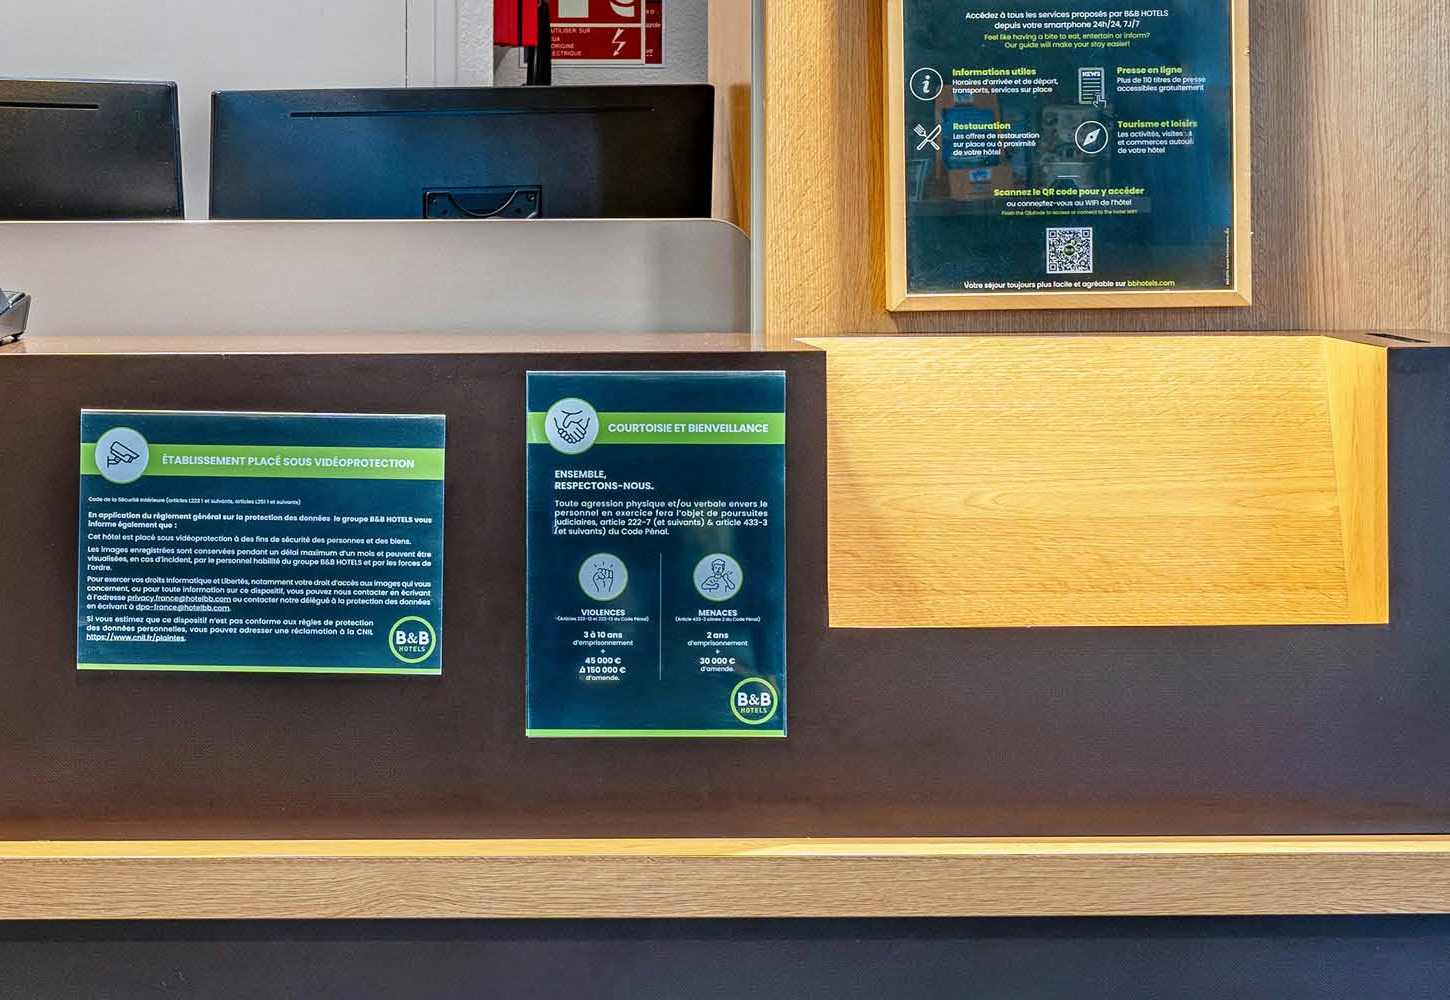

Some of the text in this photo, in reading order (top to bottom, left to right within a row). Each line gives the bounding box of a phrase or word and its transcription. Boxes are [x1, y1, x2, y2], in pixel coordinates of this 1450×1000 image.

[964, 8, 1169, 20] Accédez à tous les services proposés par B&B HOTELS
[993, 19, 1141, 31] depuis votre smartphone 24h/24, 7J/7
[951, 66, 1037, 76] Informations utiles
[1116, 66, 1146, 75] Presse
[1160, 65, 1183, 75] ligne
[951, 77, 982, 86] Horaires
[981, 77, 1014, 86] d'arrivée
[1021, 77, 1033, 85] de
[1032, 77, 1059, 86] départ,
[952, 86, 990, 95] transports,
[990, 85, 1019, 94] services
[1032, 85, 1053, 95] place
[952, 121, 1011, 130] Restauration
[1116, 119, 1198, 128] Tourisme et loisirs
[993, 186, 1145, 197] Scannez le QR code pour y accéder
[963, 280, 984, 289] Votre
[983, 281, 1006, 290] séjour
[1006, 280, 1036, 290] toujours
[1036, 280, 1053, 290] plus
[1052, 280, 1073, 288] facile
[1072, 280, 1082, 288] et
[1081, 279, 1115, 290] agréable
[1126, 279, 1176, 289] bbhotels.com
[607, 422, 769, 433] COURTOISIE ET BIENVEILLANCE
[162, 453, 415, 469] ÉTABLISSEMENT PLACÉ SOUS VIDÉOPROTECTION
[554, 469, 607, 480] ENSEMBLE,
[553, 480, 655, 490] RESPECTONS-NOUS.
[554, 499, 579, 508] Toute
[580, 499, 624, 510] agression
[625, 499, 666, 510] physique
[666, 498, 692, 509] et/ou
[693, 499, 727, 508] verbale
[759, 499, 768, 508] le
[553, 508, 769, 519] personnel en exercice fera l'objet de poursuites
[553, 517, 768, 528] judiciaires, article 222-7 (et suivants) & article 433-3
[87, 532, 412, 545] Cet hôtel est placé sous vidéoprotection à des fins de sécurité des personnes et des biens.
[580, 608, 626, 617] VIOLENCES
[697, 608, 738, 617] MENACES
[395, 630, 430, 645] B&B
[582, 630, 589, 639] 3
[589, 630, 596, 639] à
[596, 630, 606, 639] 10
[705, 631, 712, 639] 2
[571, 639, 634, 647] d'emprisonnement
[686, 639, 749, 648] d'emprisonnement
[584, 656, 621, 665] 45 000 €
[699, 656, 736, 665] 30 000 €
[579, 665, 626, 674] à 150 000 €
[737, 692, 772, 707] B&B
